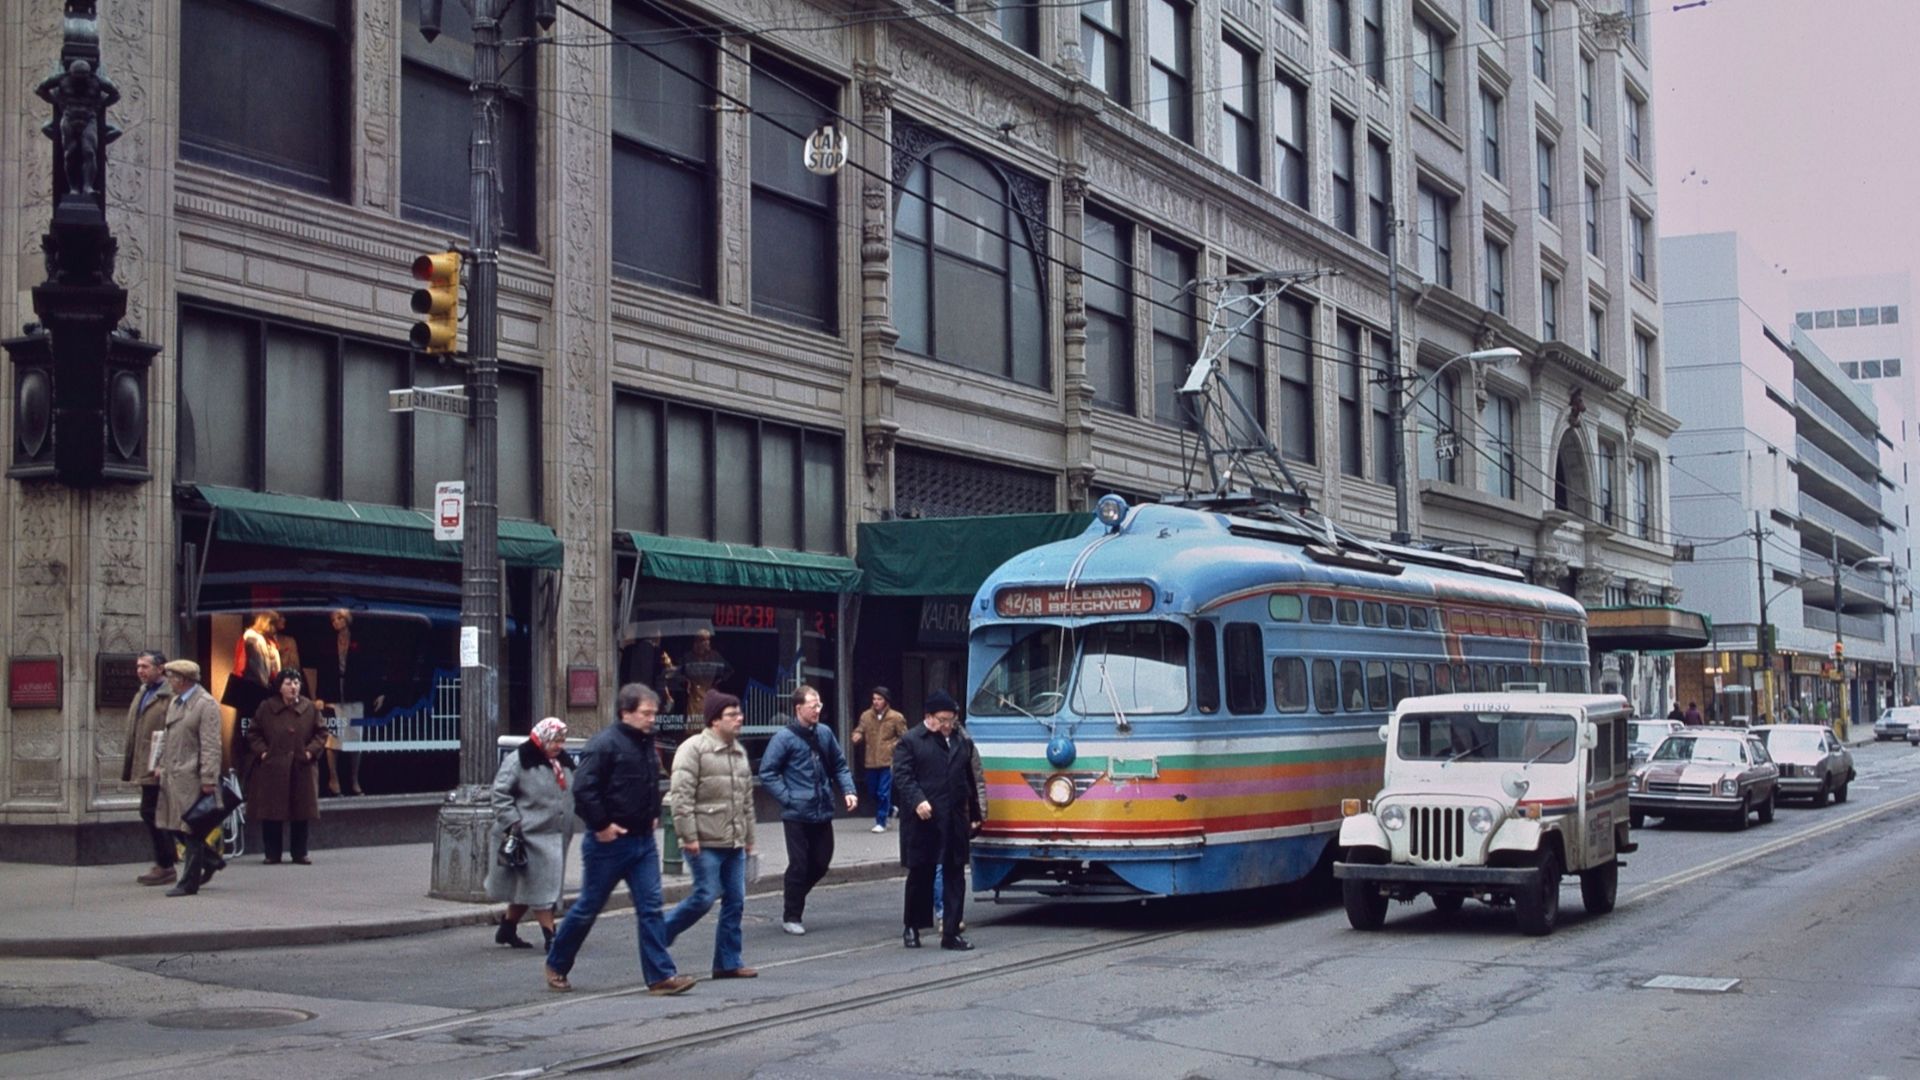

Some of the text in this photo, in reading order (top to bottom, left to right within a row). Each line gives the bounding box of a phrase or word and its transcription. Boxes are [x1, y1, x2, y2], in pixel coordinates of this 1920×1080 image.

[812, 133, 842, 150] CAR
[809, 151, 844, 169] STOP
[1436, 446, 1460, 460] CAR
[1072, 587, 1142, 601] LEBANON
[1004, 592, 1042, 614] 42/38
[1047, 599, 1142, 613] BEECHVIEW
